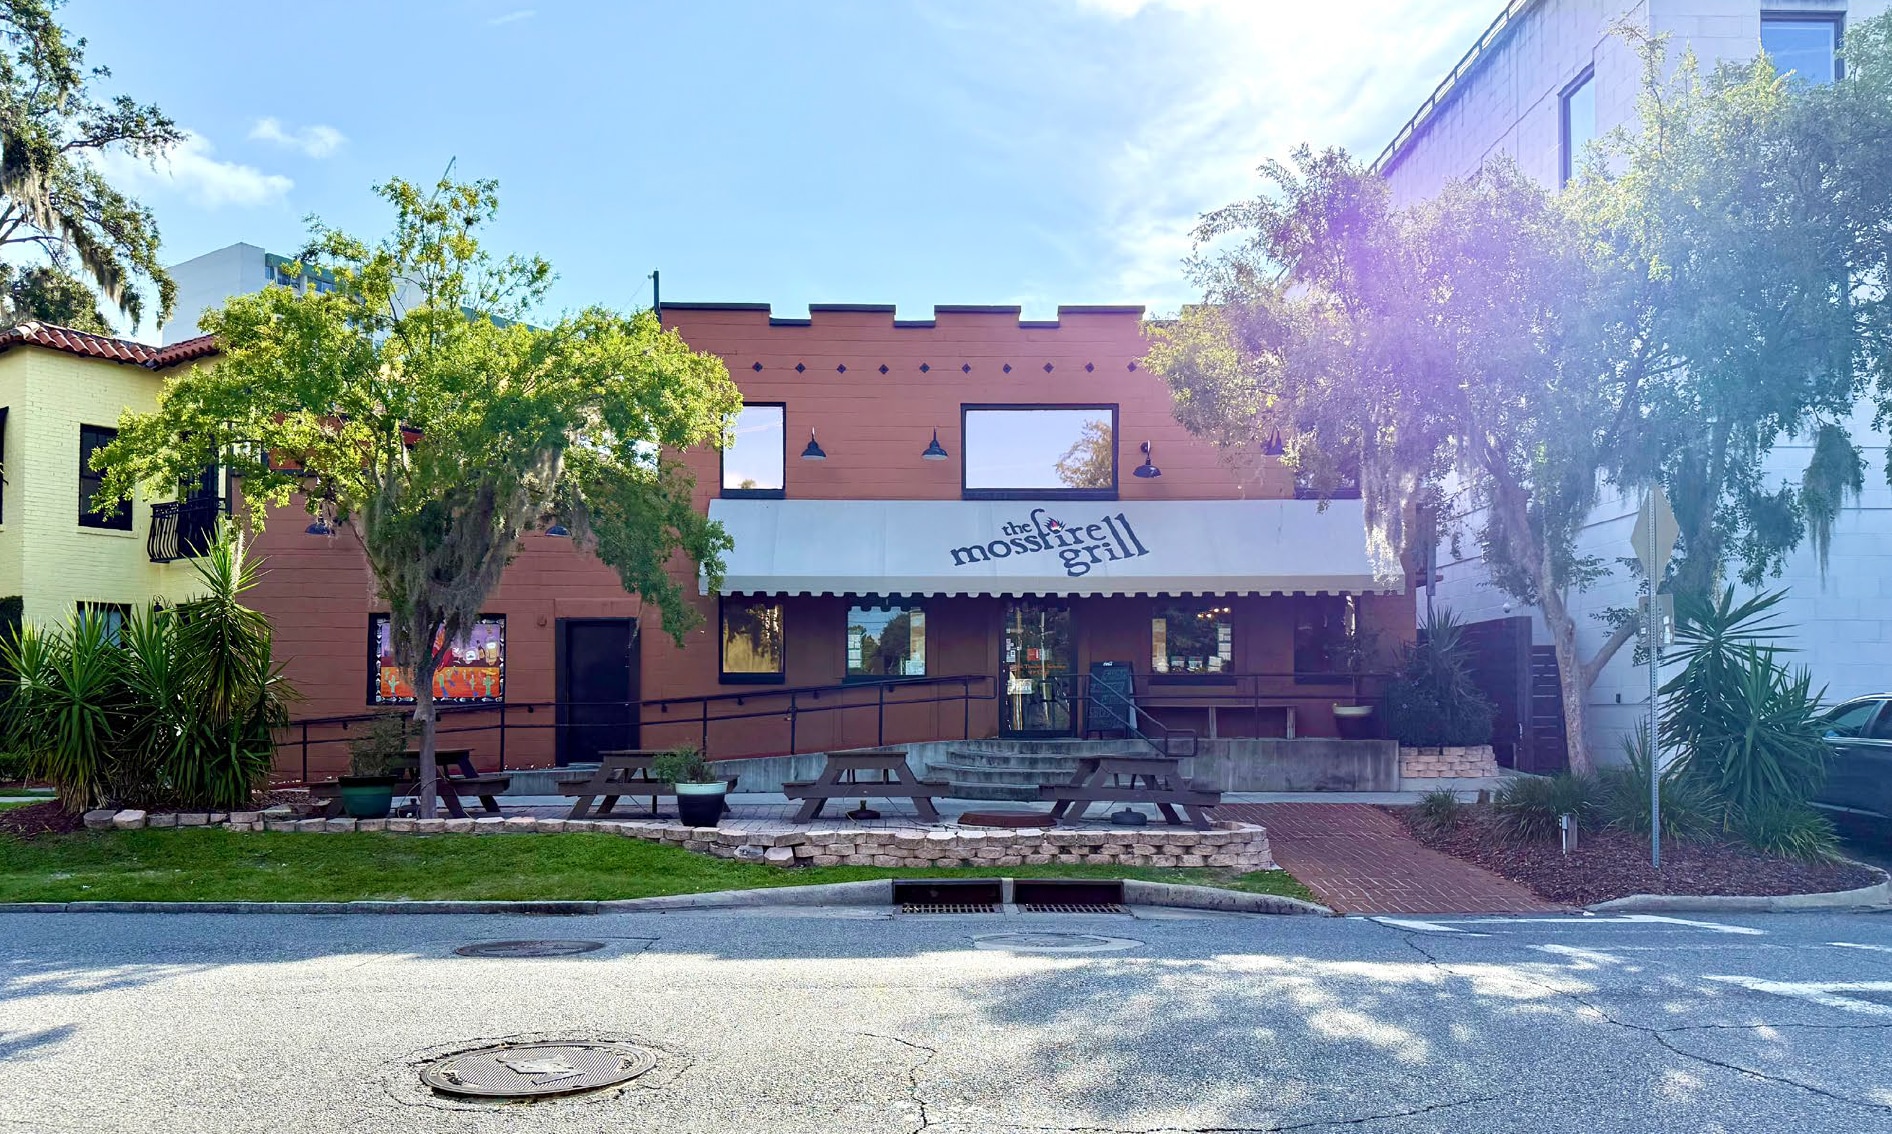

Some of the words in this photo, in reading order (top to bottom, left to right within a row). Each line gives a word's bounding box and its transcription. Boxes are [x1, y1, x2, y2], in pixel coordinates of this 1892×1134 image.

[949, 508, 1107, 567] mossfire
[1001, 521, 1033, 537] the
[1058, 512, 1150, 578] grill
